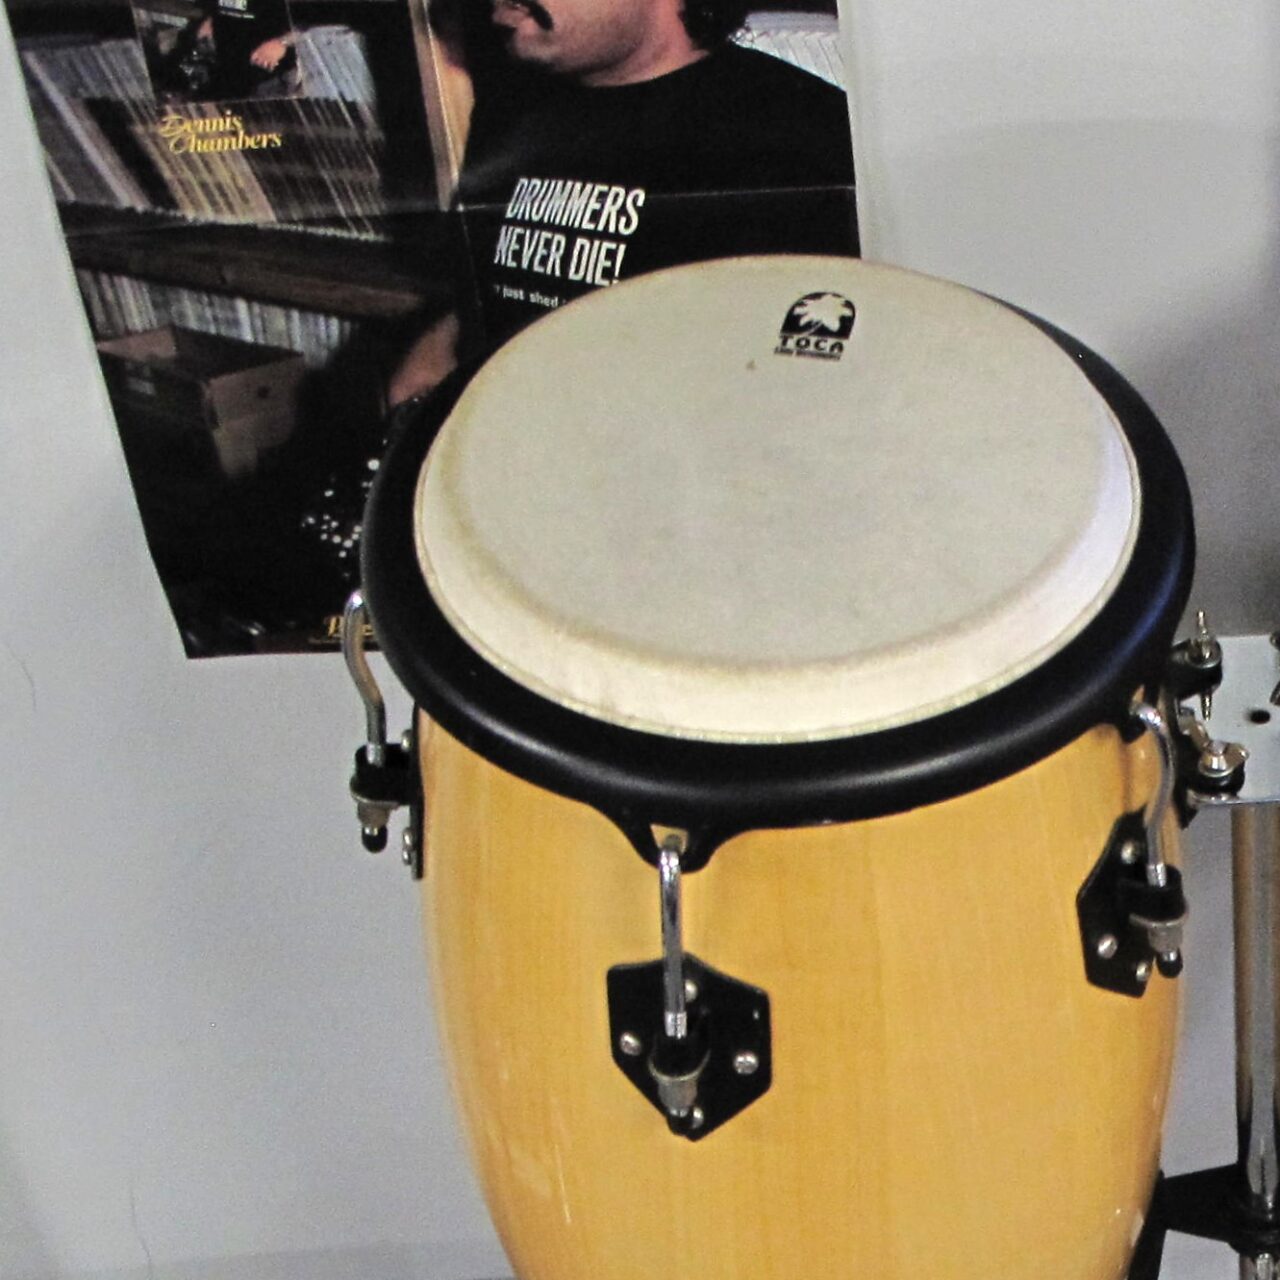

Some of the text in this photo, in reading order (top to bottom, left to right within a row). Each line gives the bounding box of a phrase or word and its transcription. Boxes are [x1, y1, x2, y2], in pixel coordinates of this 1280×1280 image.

[160, 110, 243, 137] Dennis
[169, 129, 282, 154] Chambers
[505, 178, 645, 236] DRUMMERS
[494, 225, 626, 287] NEVER DIE!
[779, 335, 844, 353] TOCA
